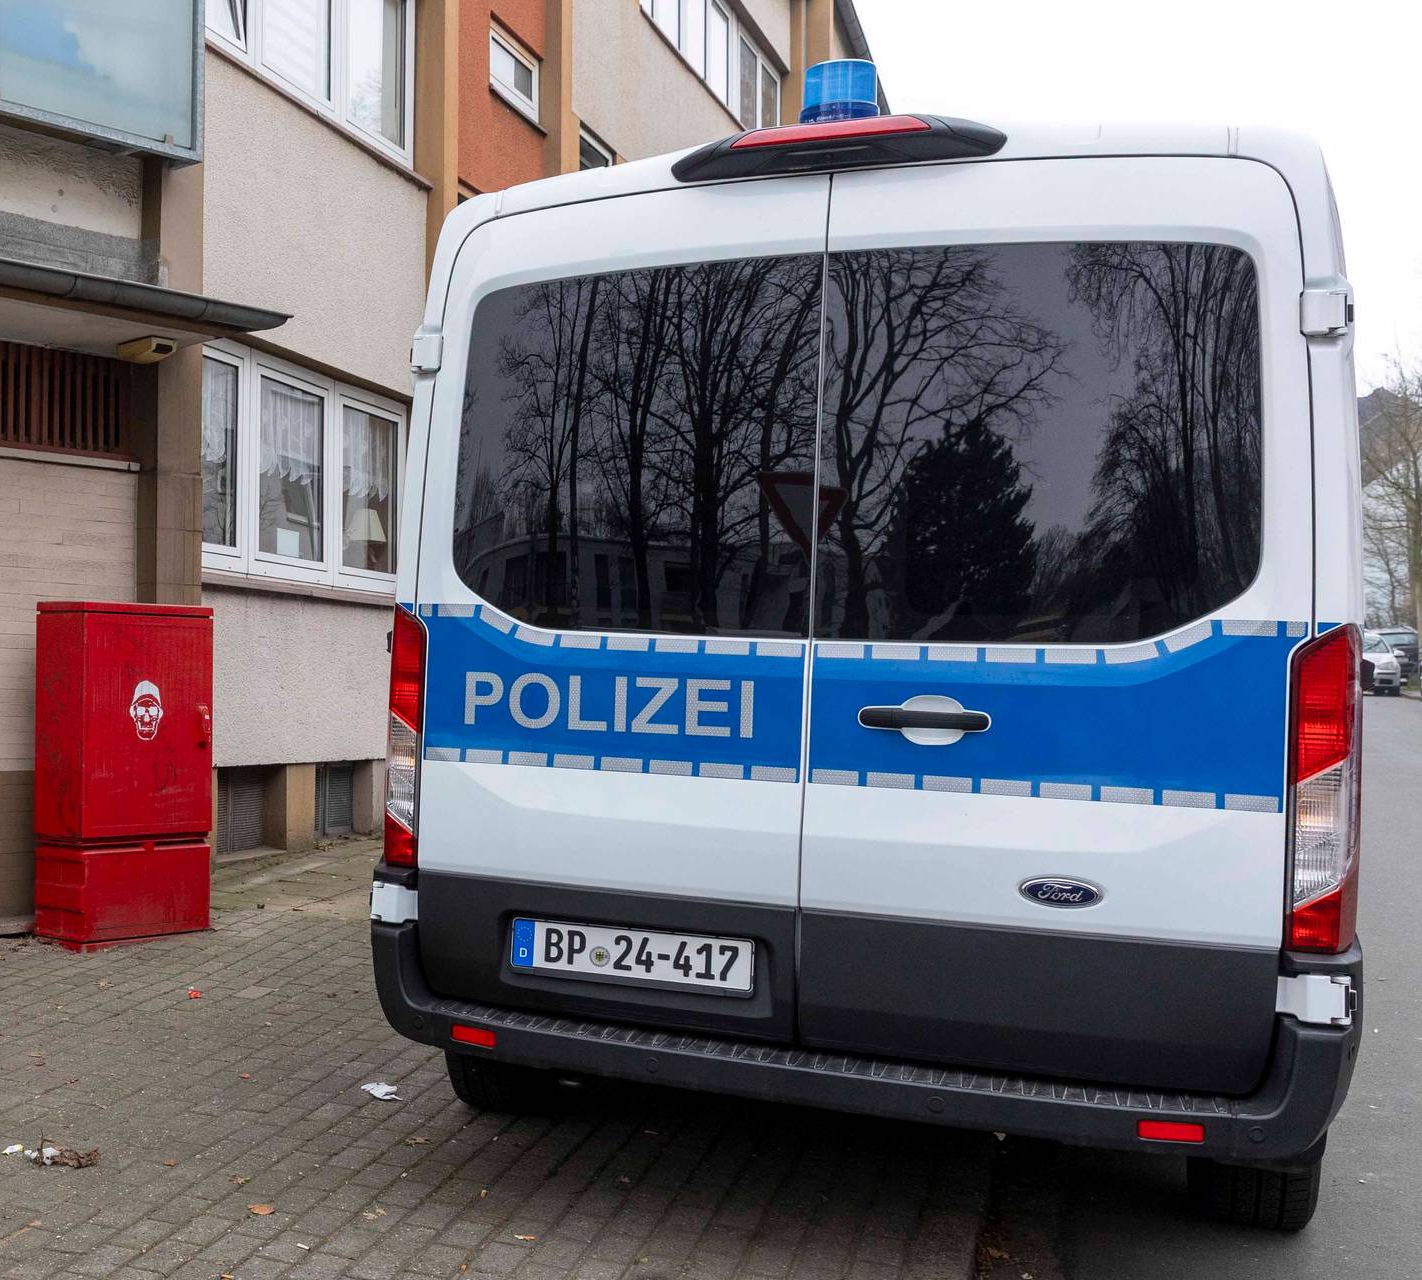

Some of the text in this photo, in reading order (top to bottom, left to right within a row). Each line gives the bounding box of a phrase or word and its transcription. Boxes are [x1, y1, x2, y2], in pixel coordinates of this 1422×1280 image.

[464, 671, 754, 738] POLIZEI
[1038, 883, 1084, 902] Ford
[519, 947, 528, 958] D
[544, 928, 739, 981] BP 24-417
